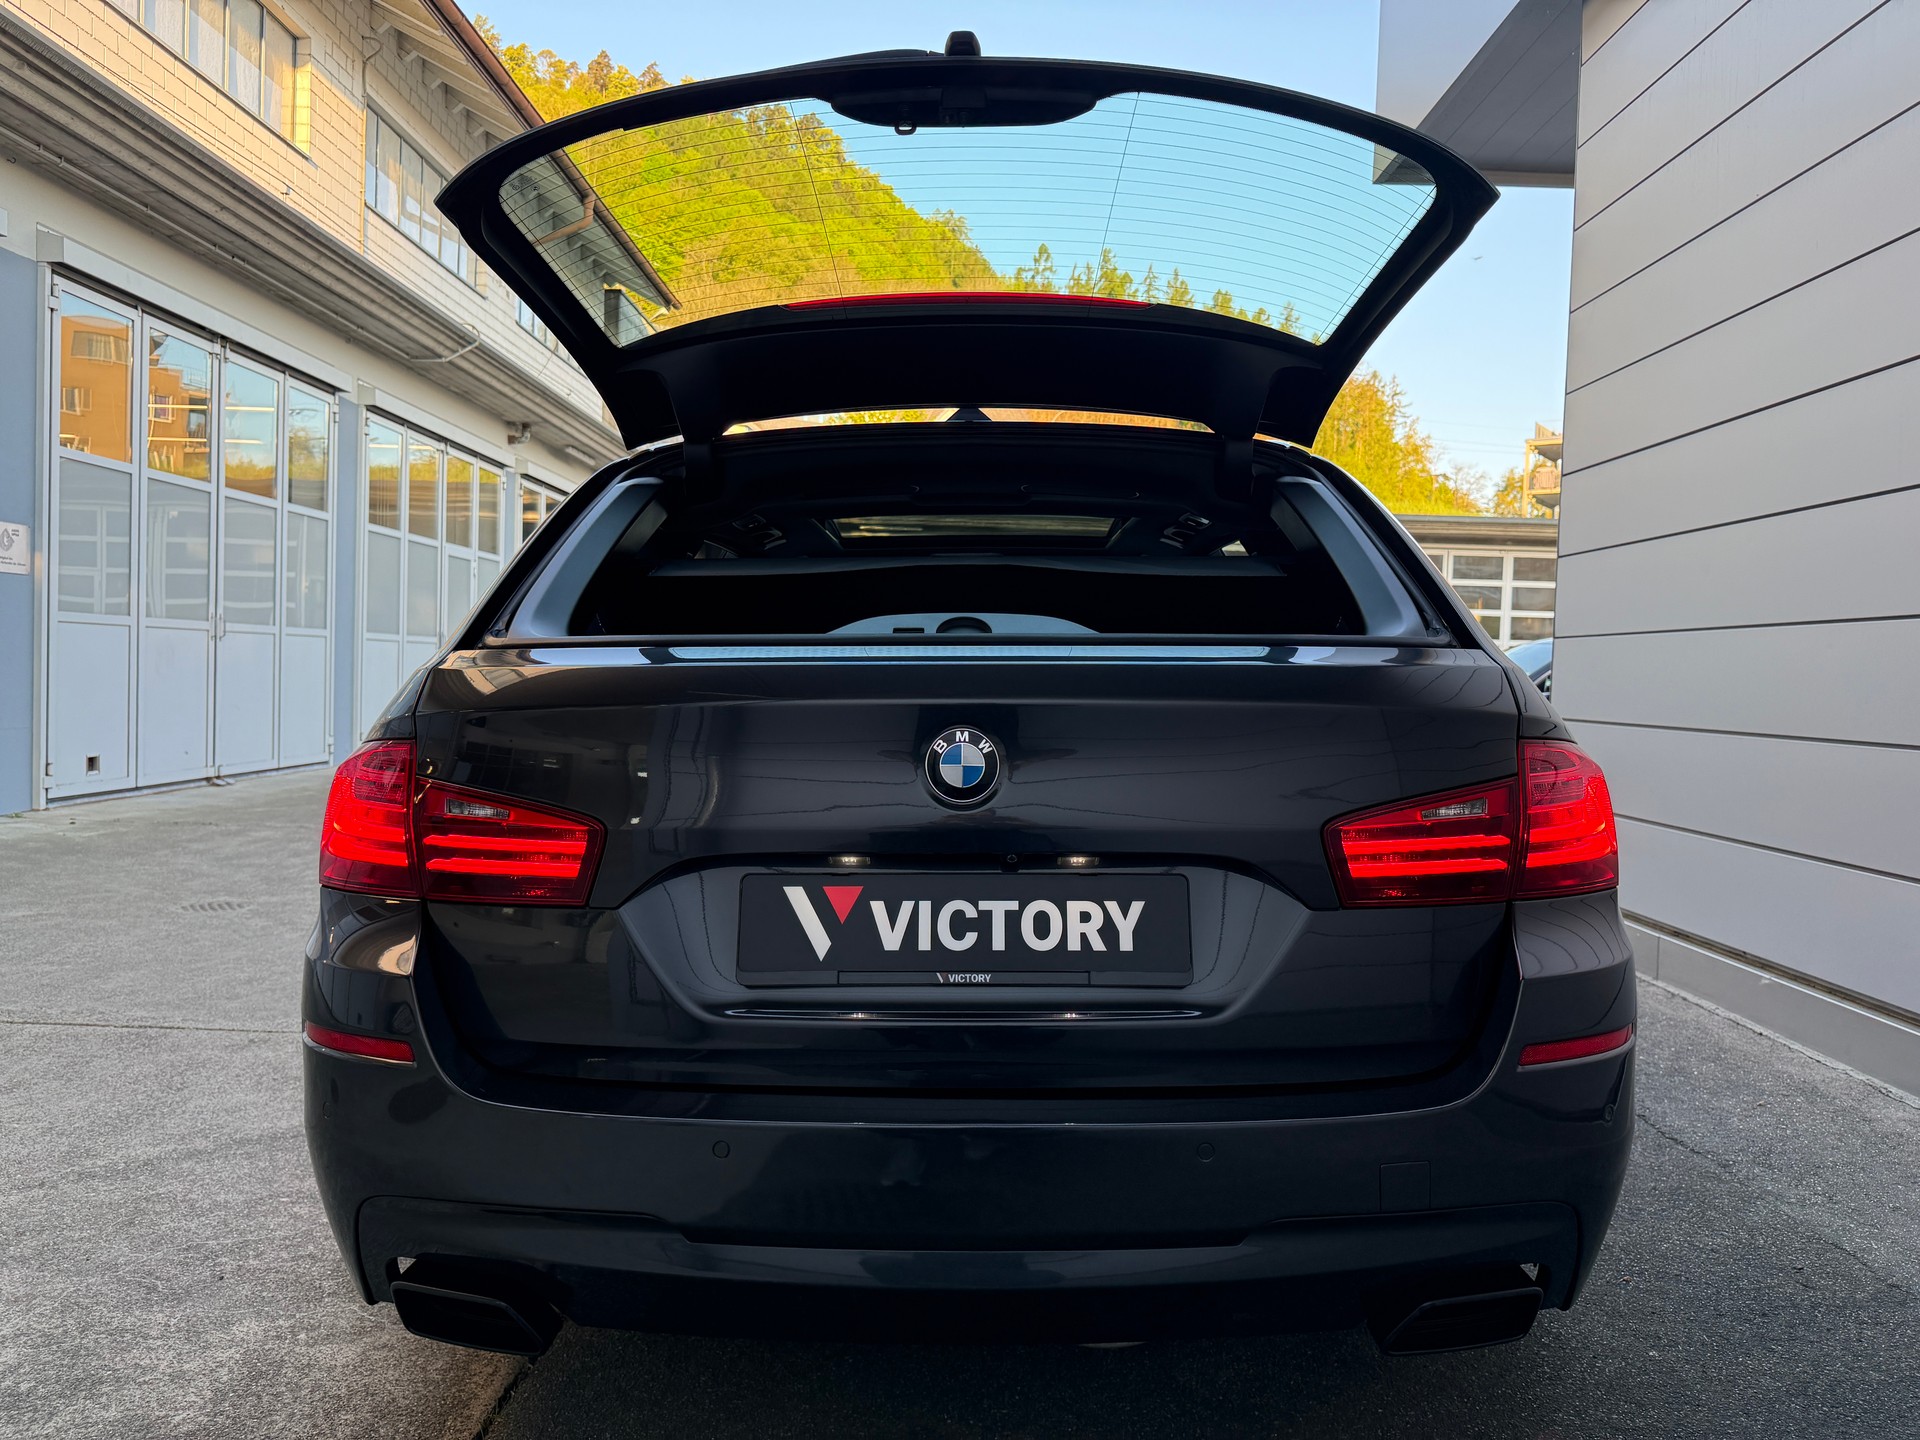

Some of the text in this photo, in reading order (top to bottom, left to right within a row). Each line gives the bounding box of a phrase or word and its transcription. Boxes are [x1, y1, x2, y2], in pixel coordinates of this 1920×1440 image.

[933, 731, 993, 754] BMW
[870, 900, 1145, 951] VICTORY
[948, 974, 992, 983] VICTORY
